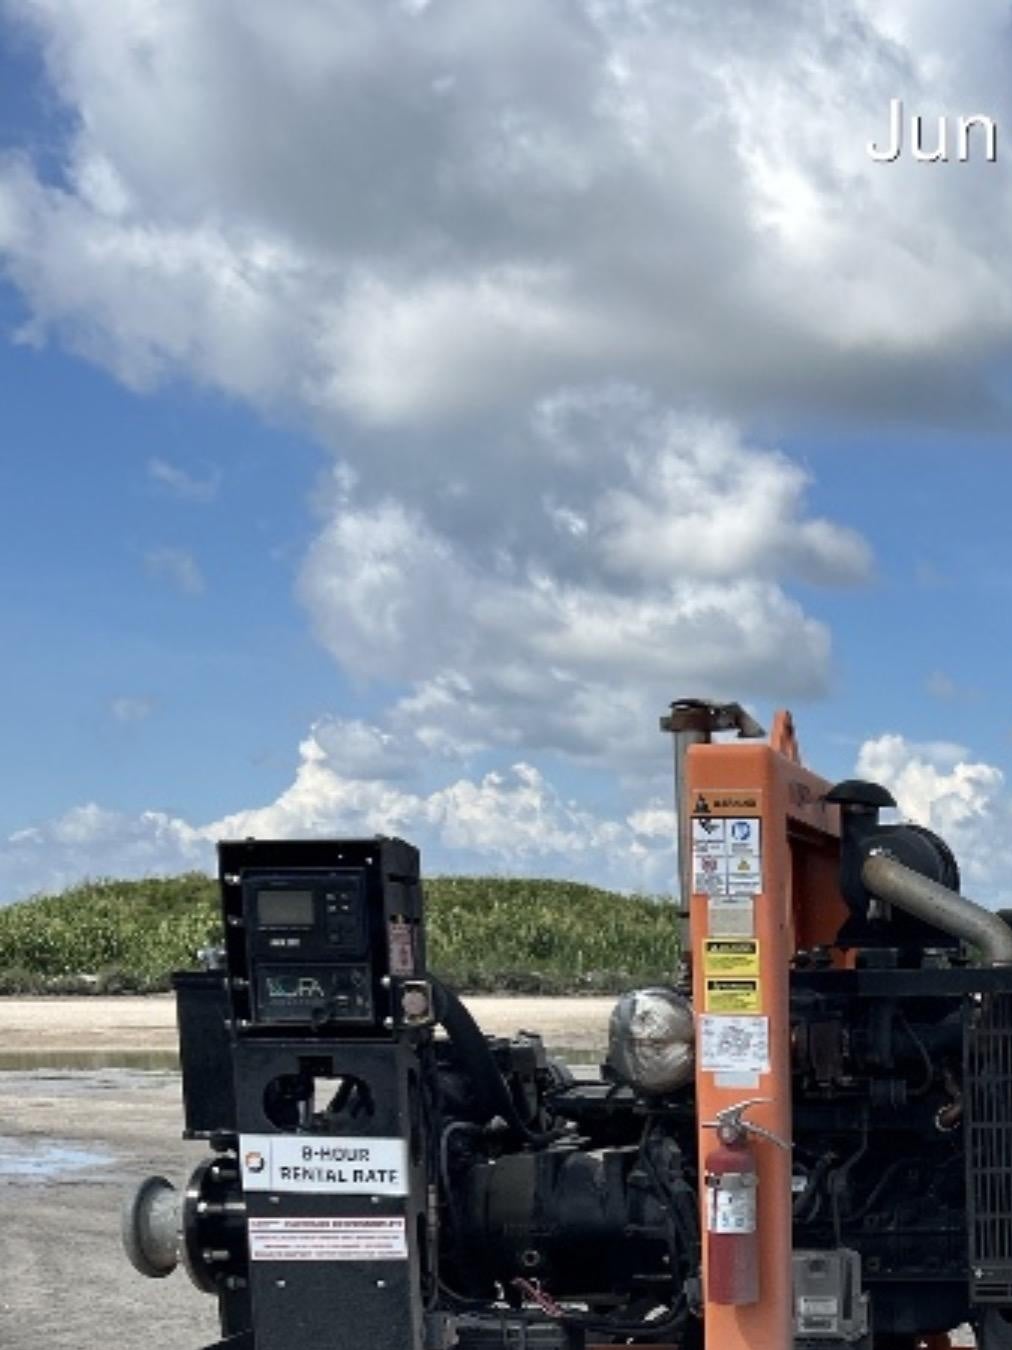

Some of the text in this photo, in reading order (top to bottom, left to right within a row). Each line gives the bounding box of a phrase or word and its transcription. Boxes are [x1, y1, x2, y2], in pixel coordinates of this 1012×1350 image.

[301, 1145, 370, 1163] 8-HOUR
[279, 1165, 400, 1184] RENTAL RATE
